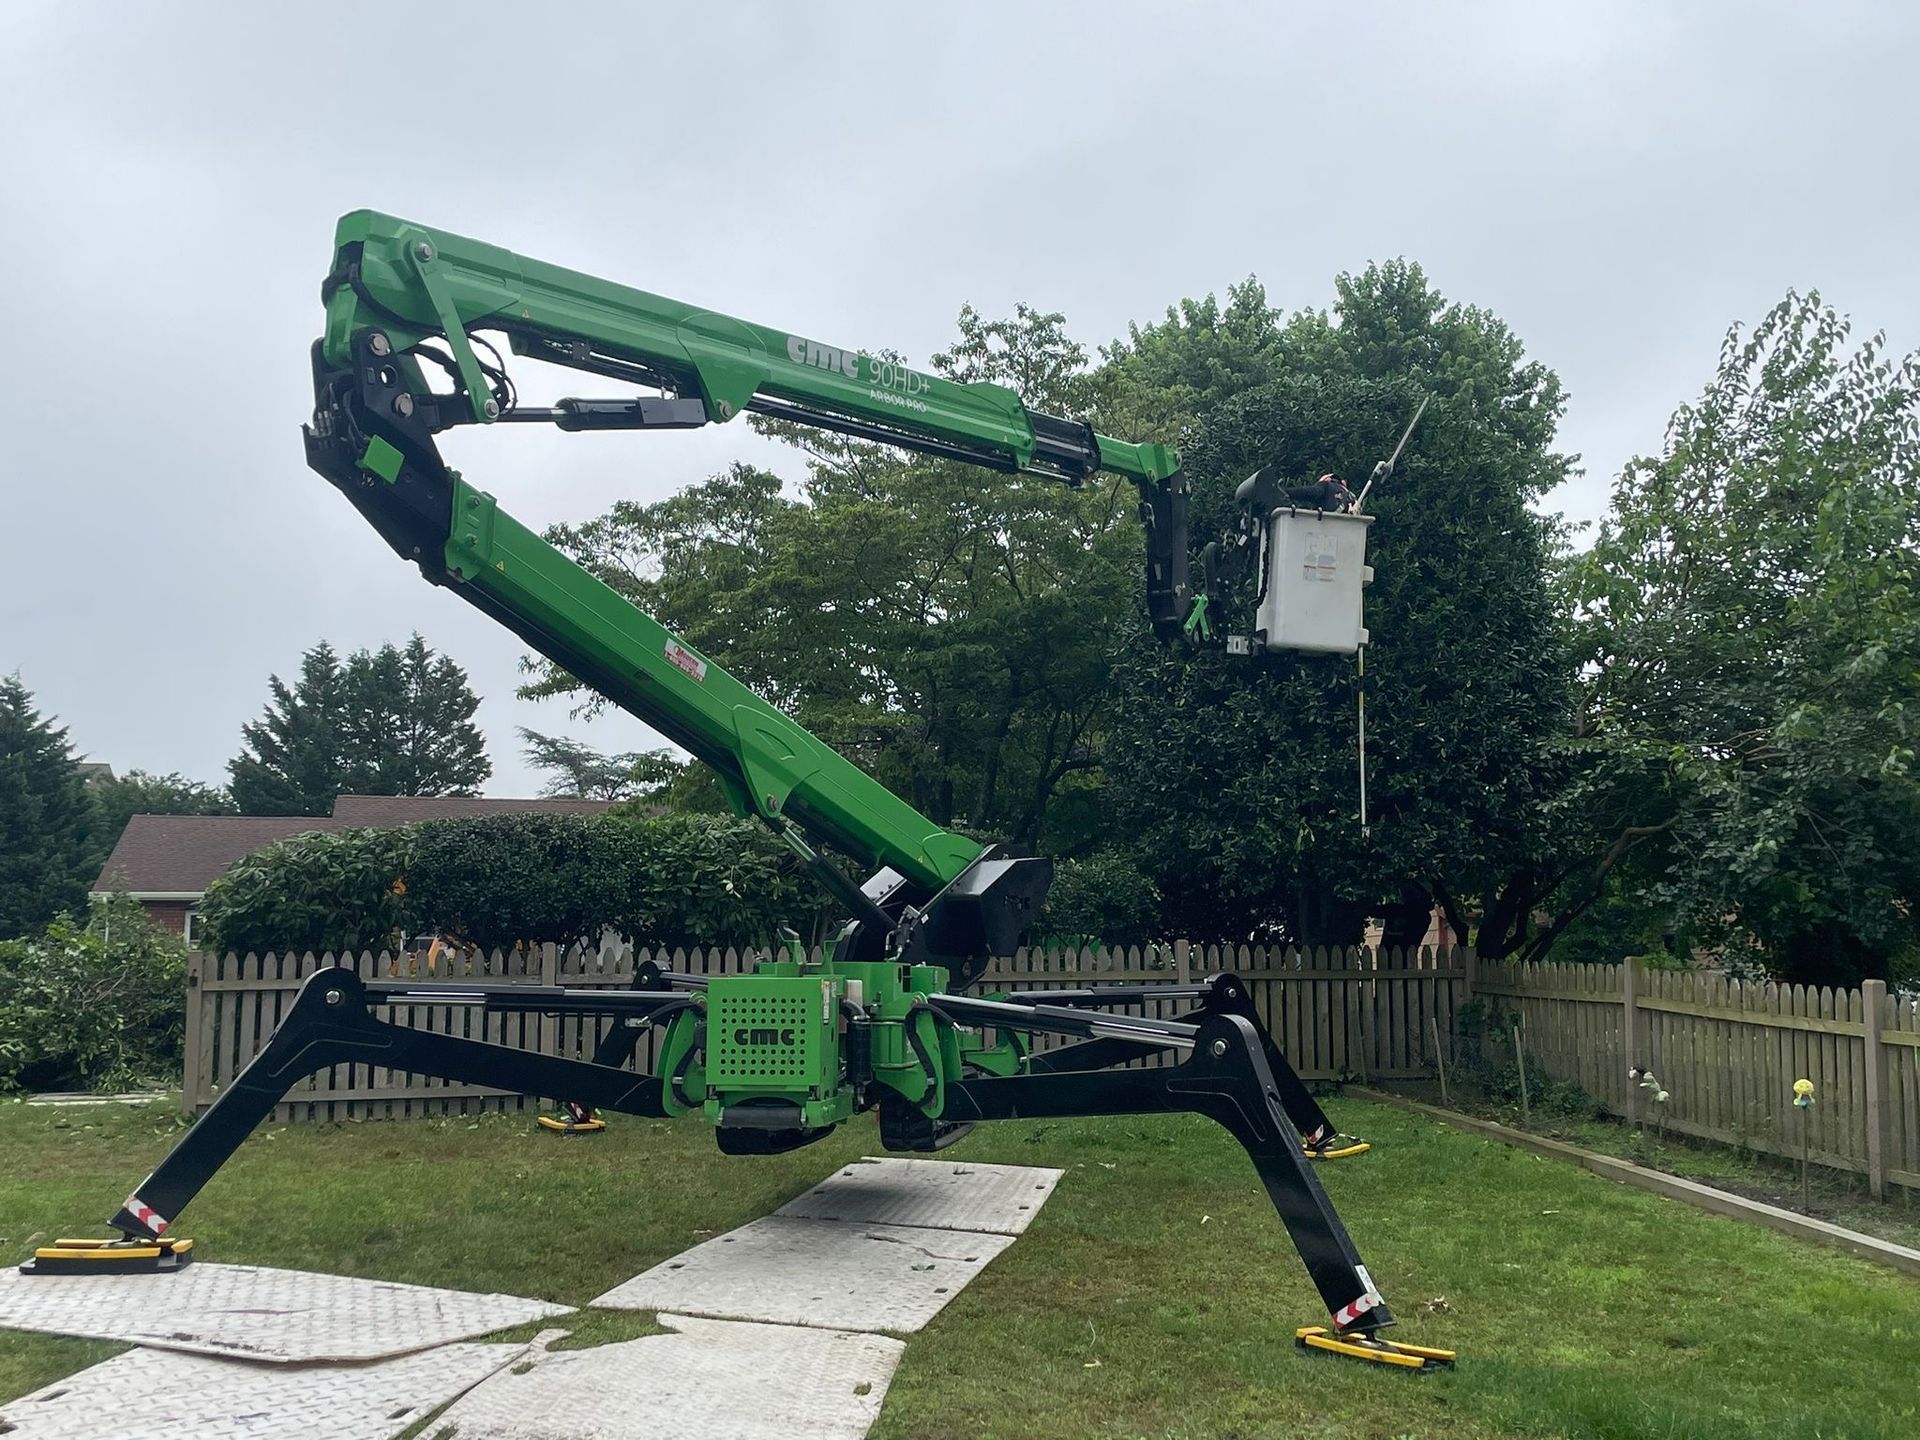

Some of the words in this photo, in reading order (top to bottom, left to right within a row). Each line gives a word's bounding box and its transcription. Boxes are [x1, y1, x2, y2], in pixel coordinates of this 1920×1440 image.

[869, 360, 931, 394] 90HD+
[870, 389, 905, 407] ARBOR
[906, 398, 927, 412] PRO
